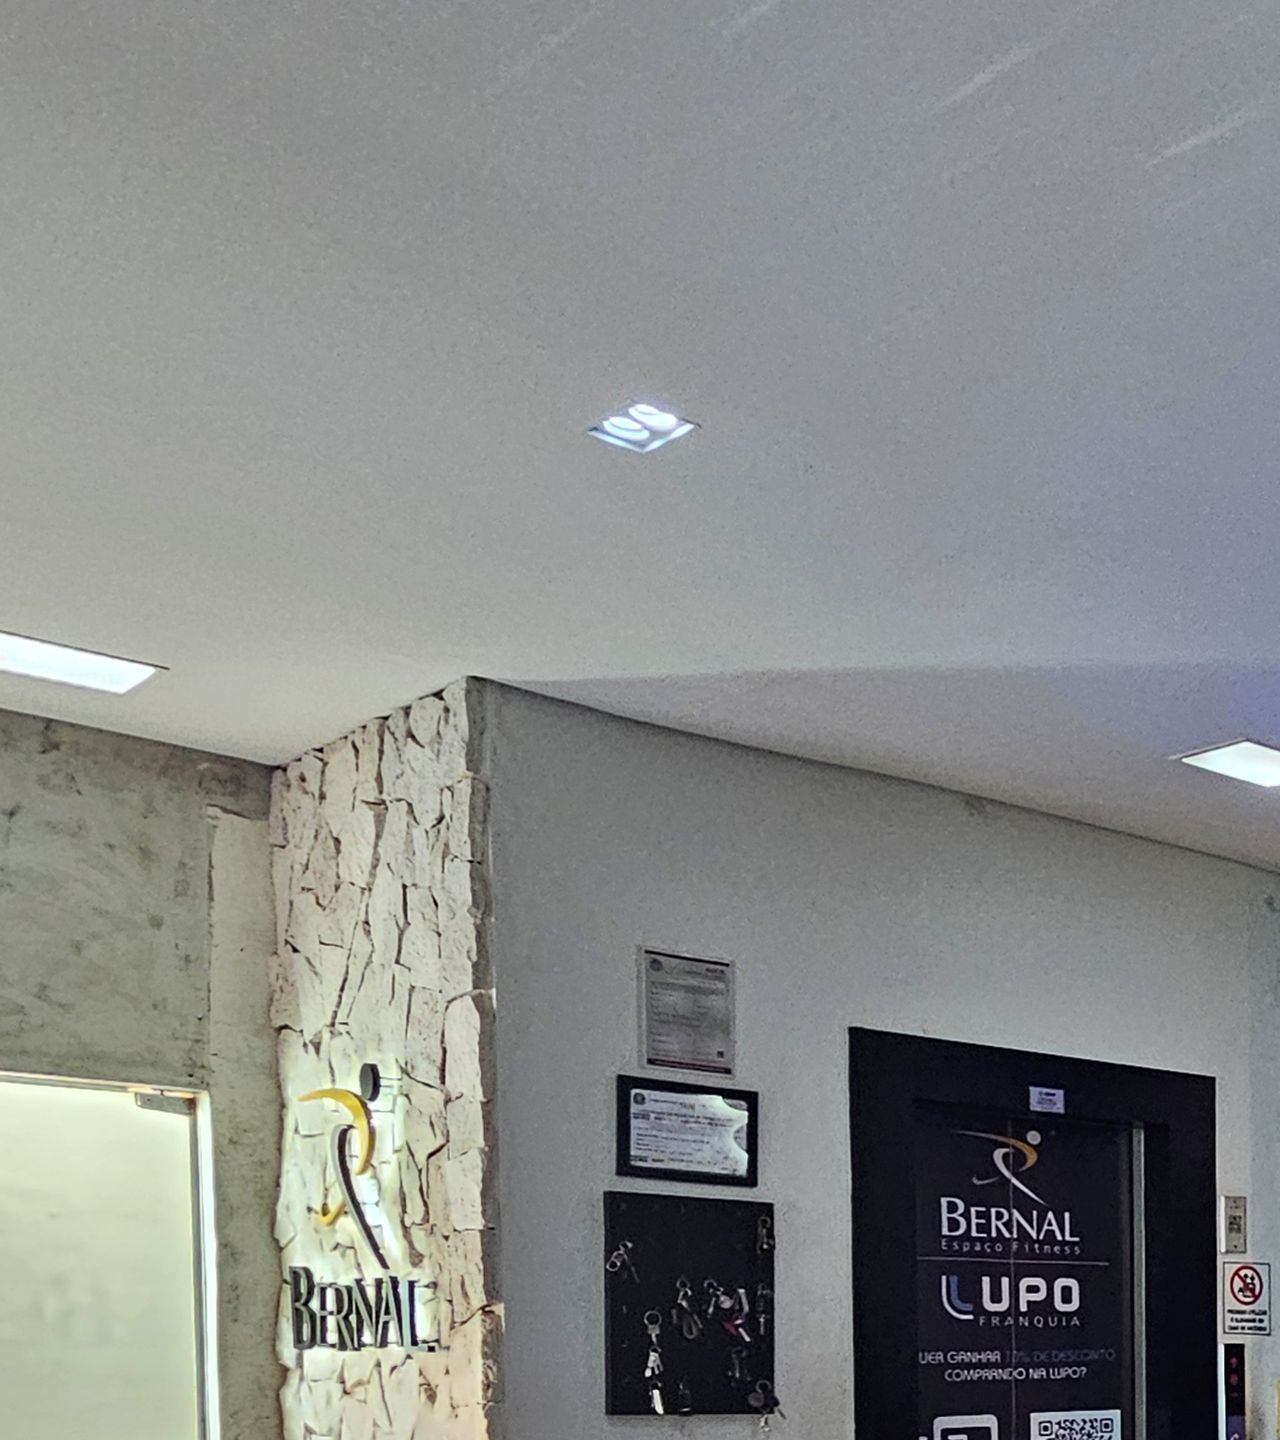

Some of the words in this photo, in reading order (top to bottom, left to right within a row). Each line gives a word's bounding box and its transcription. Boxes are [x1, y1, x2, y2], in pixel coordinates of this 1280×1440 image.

[940, 1196, 1081, 1242] BERNAL
[941, 1238, 1003, 1253] Espaço
[1012, 1241, 1081, 1256] Fitness
[941, 1275, 1081, 1320] LUPO
[289, 1266, 438, 1352] BERNAL
[979, 1316, 1081, 1328] FRANQUIA
[918, 1351, 945, 1364] UER
[947, 1350, 1001, 1364] GANHAR
[944, 1367, 1026, 1382] COMPRANDO
[1028, 1367, 1048, 1380] NA
